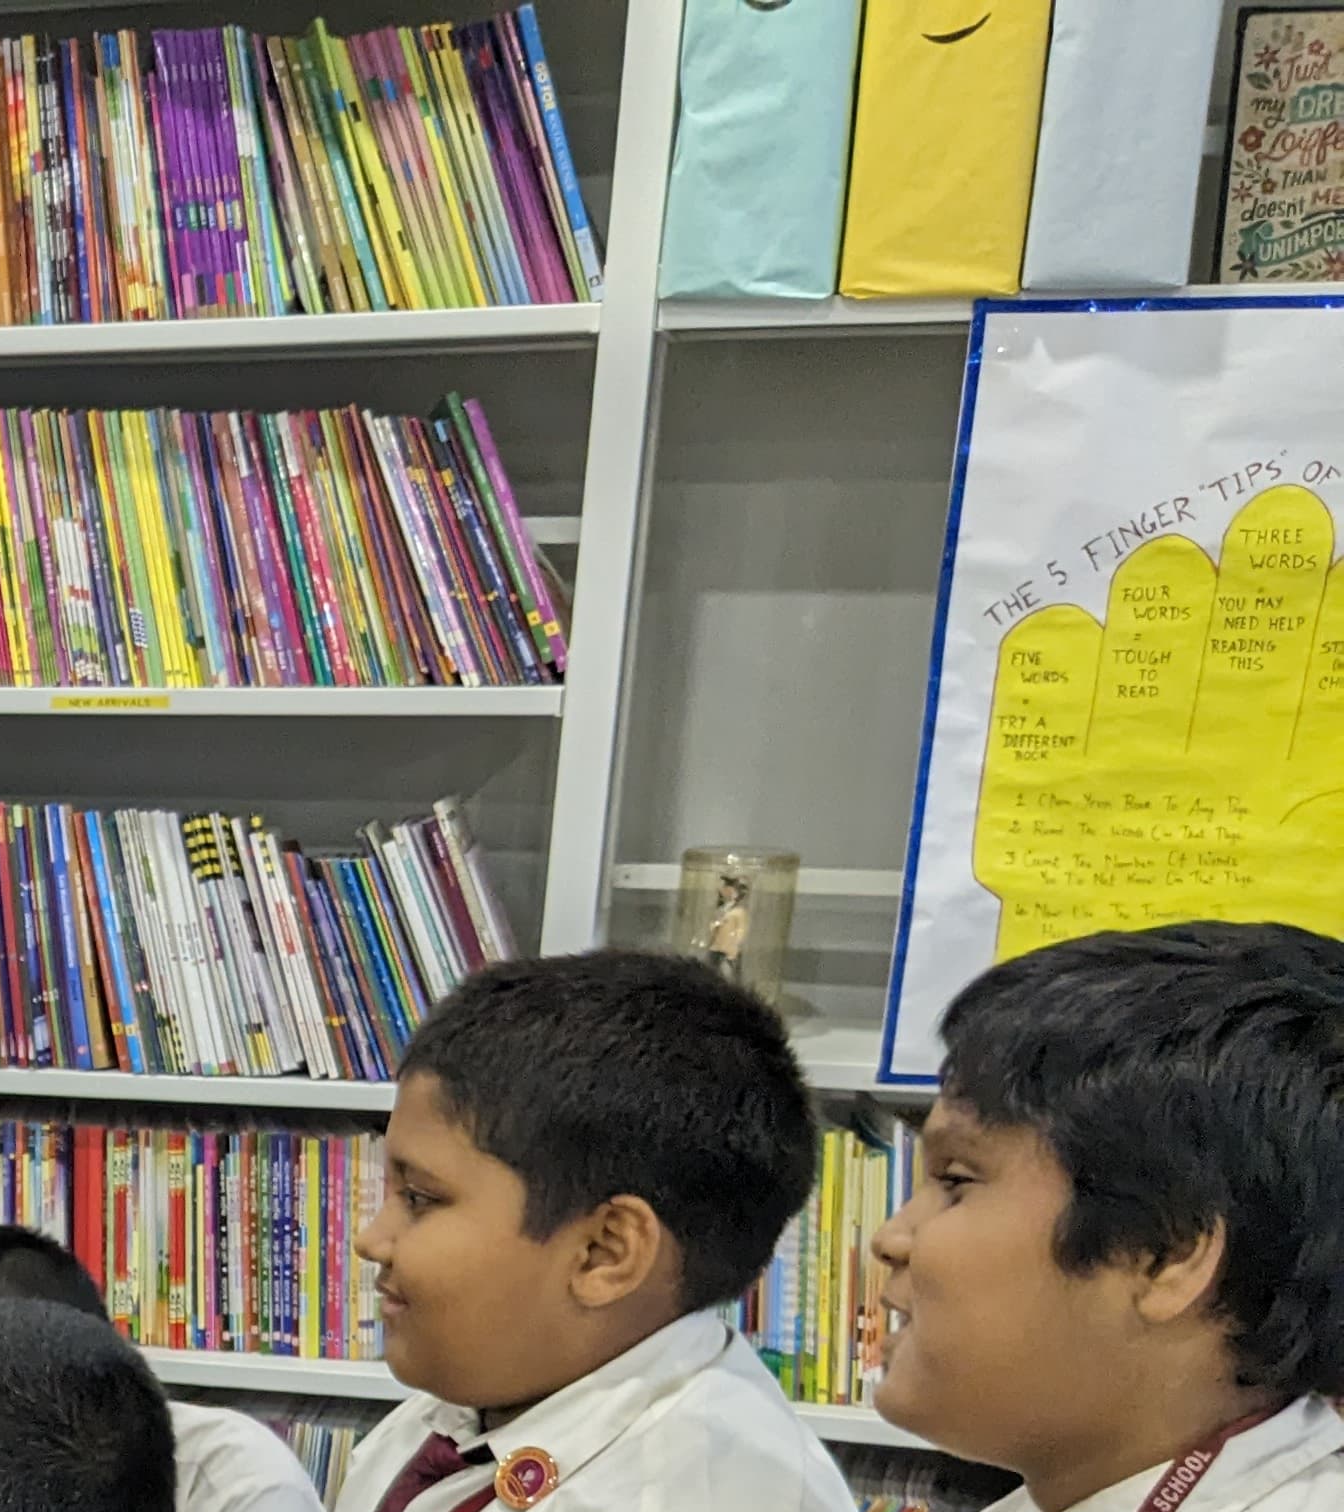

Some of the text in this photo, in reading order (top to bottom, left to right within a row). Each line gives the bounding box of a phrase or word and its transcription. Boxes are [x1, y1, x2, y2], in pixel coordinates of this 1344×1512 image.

[1239, 527, 1304, 546] THREE
[983, 580, 1042, 626] THE
[1046, 561, 1068, 587] 5
[1080, 496, 1197, 573] FINGER
[1250, 553, 1318, 571] WORDS
[1122, 585, 1171, 603] FOUR
[1218, 597, 1251, 612] YOU
[1133, 606, 1192, 620] WORDS
[1269, 616, 1306, 631] HELP
[1211, 638, 1278, 655] READING
[1011, 651, 1043, 666] FIVE
[1113, 648, 1172, 666] TOUGH
[1229, 655, 1265, 672] THIS
[1021, 671, 1070, 684] WORDS
[1139, 668, 1158, 681] TO
[1117, 685, 1160, 698] READ
[1035, 716, 1046, 728] A
[1156, 1449, 1212, 1512] SCHOOL
